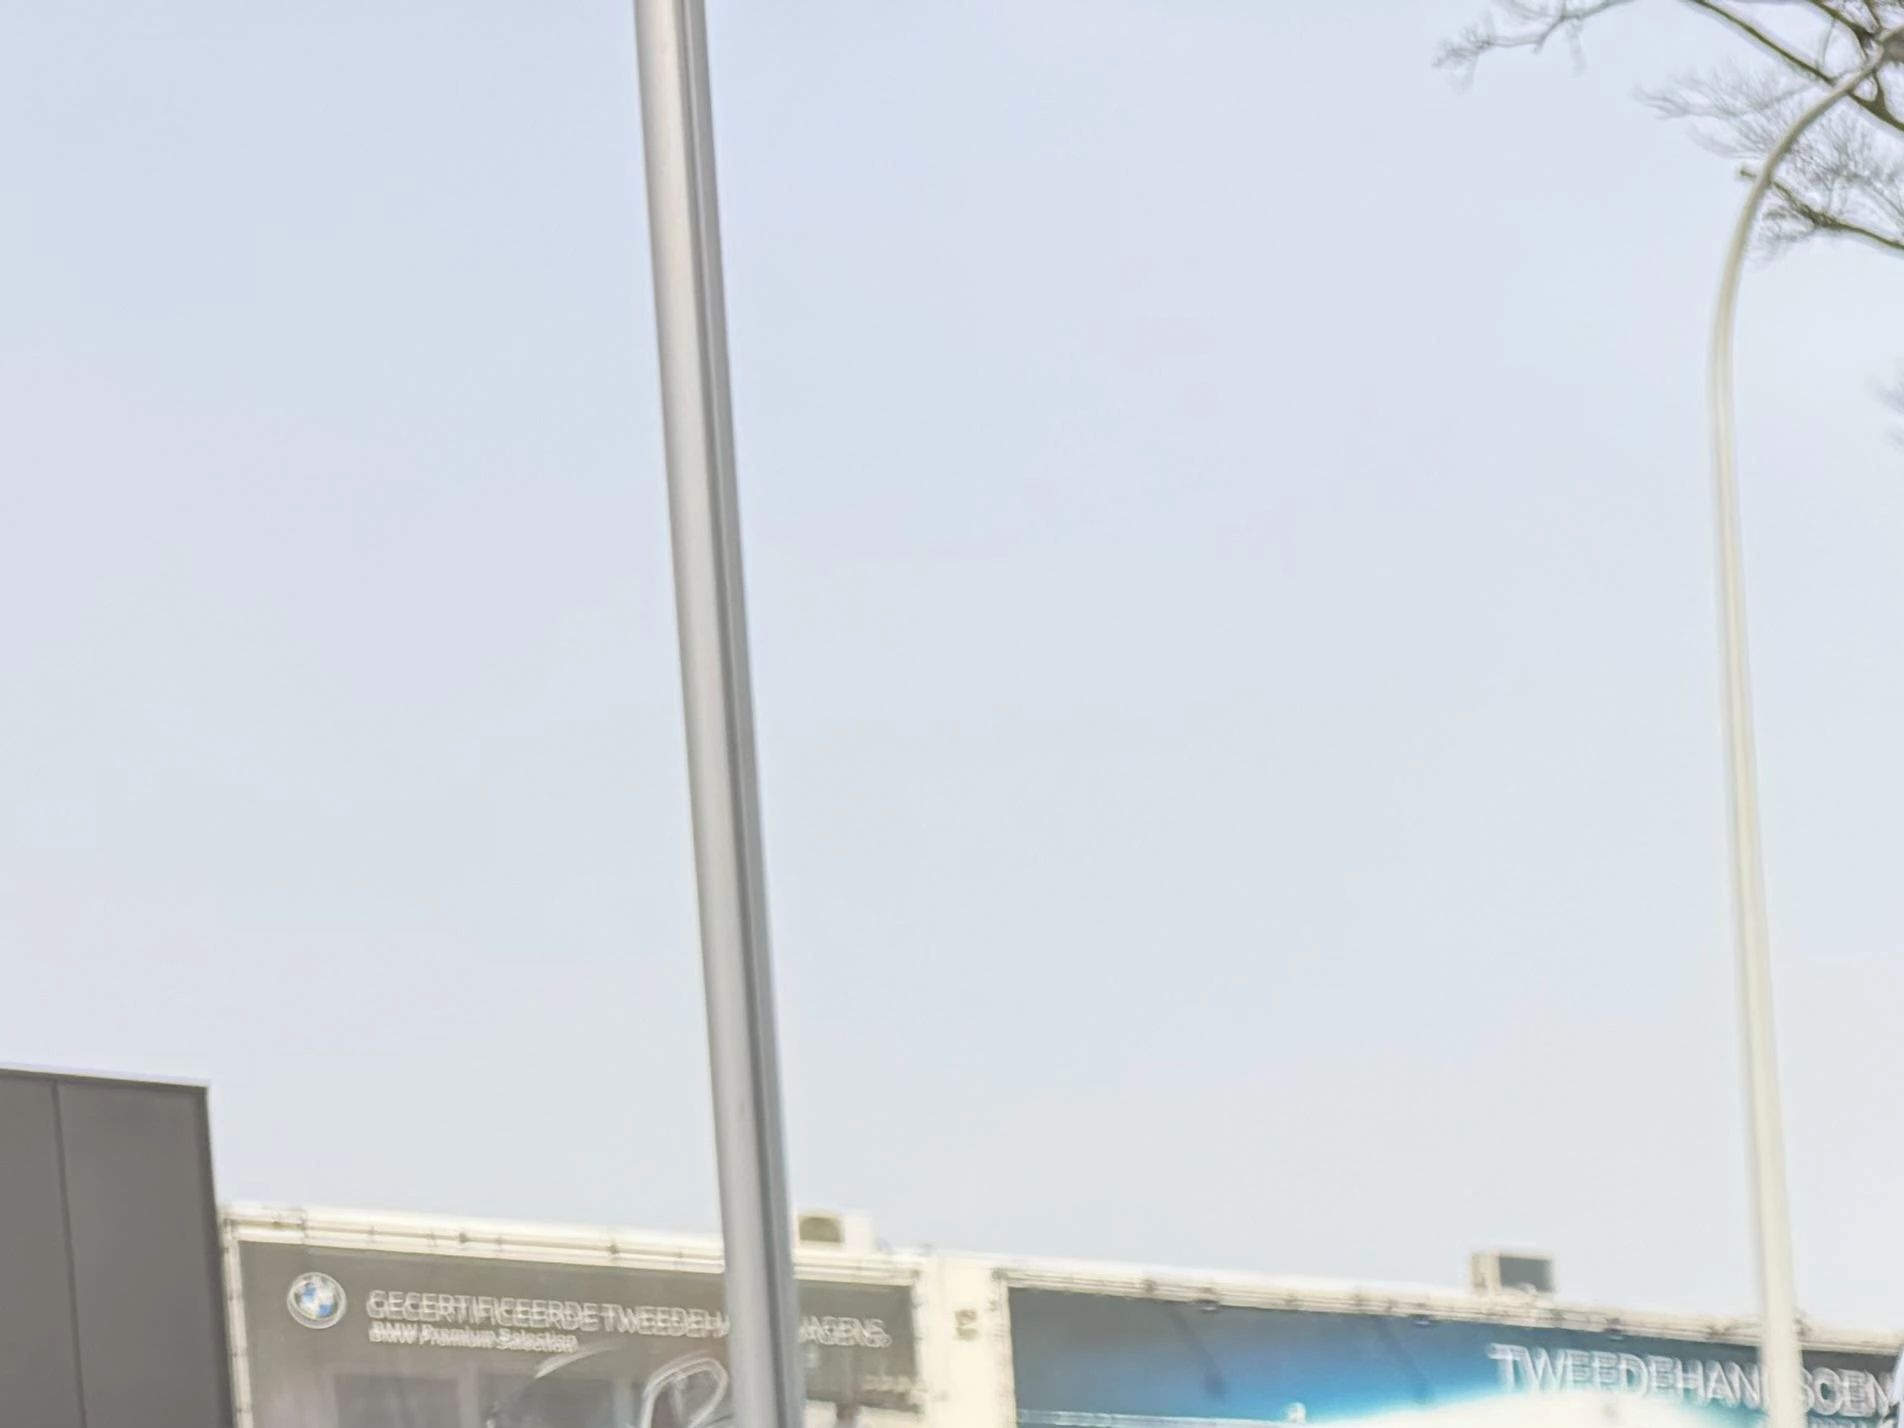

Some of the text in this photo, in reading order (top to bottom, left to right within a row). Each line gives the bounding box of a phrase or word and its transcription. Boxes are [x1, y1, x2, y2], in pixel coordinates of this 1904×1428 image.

[366, 1290, 598, 1331] GECERTIFICEERDE
[369, 1321, 580, 1353] BMW Premium Selection
